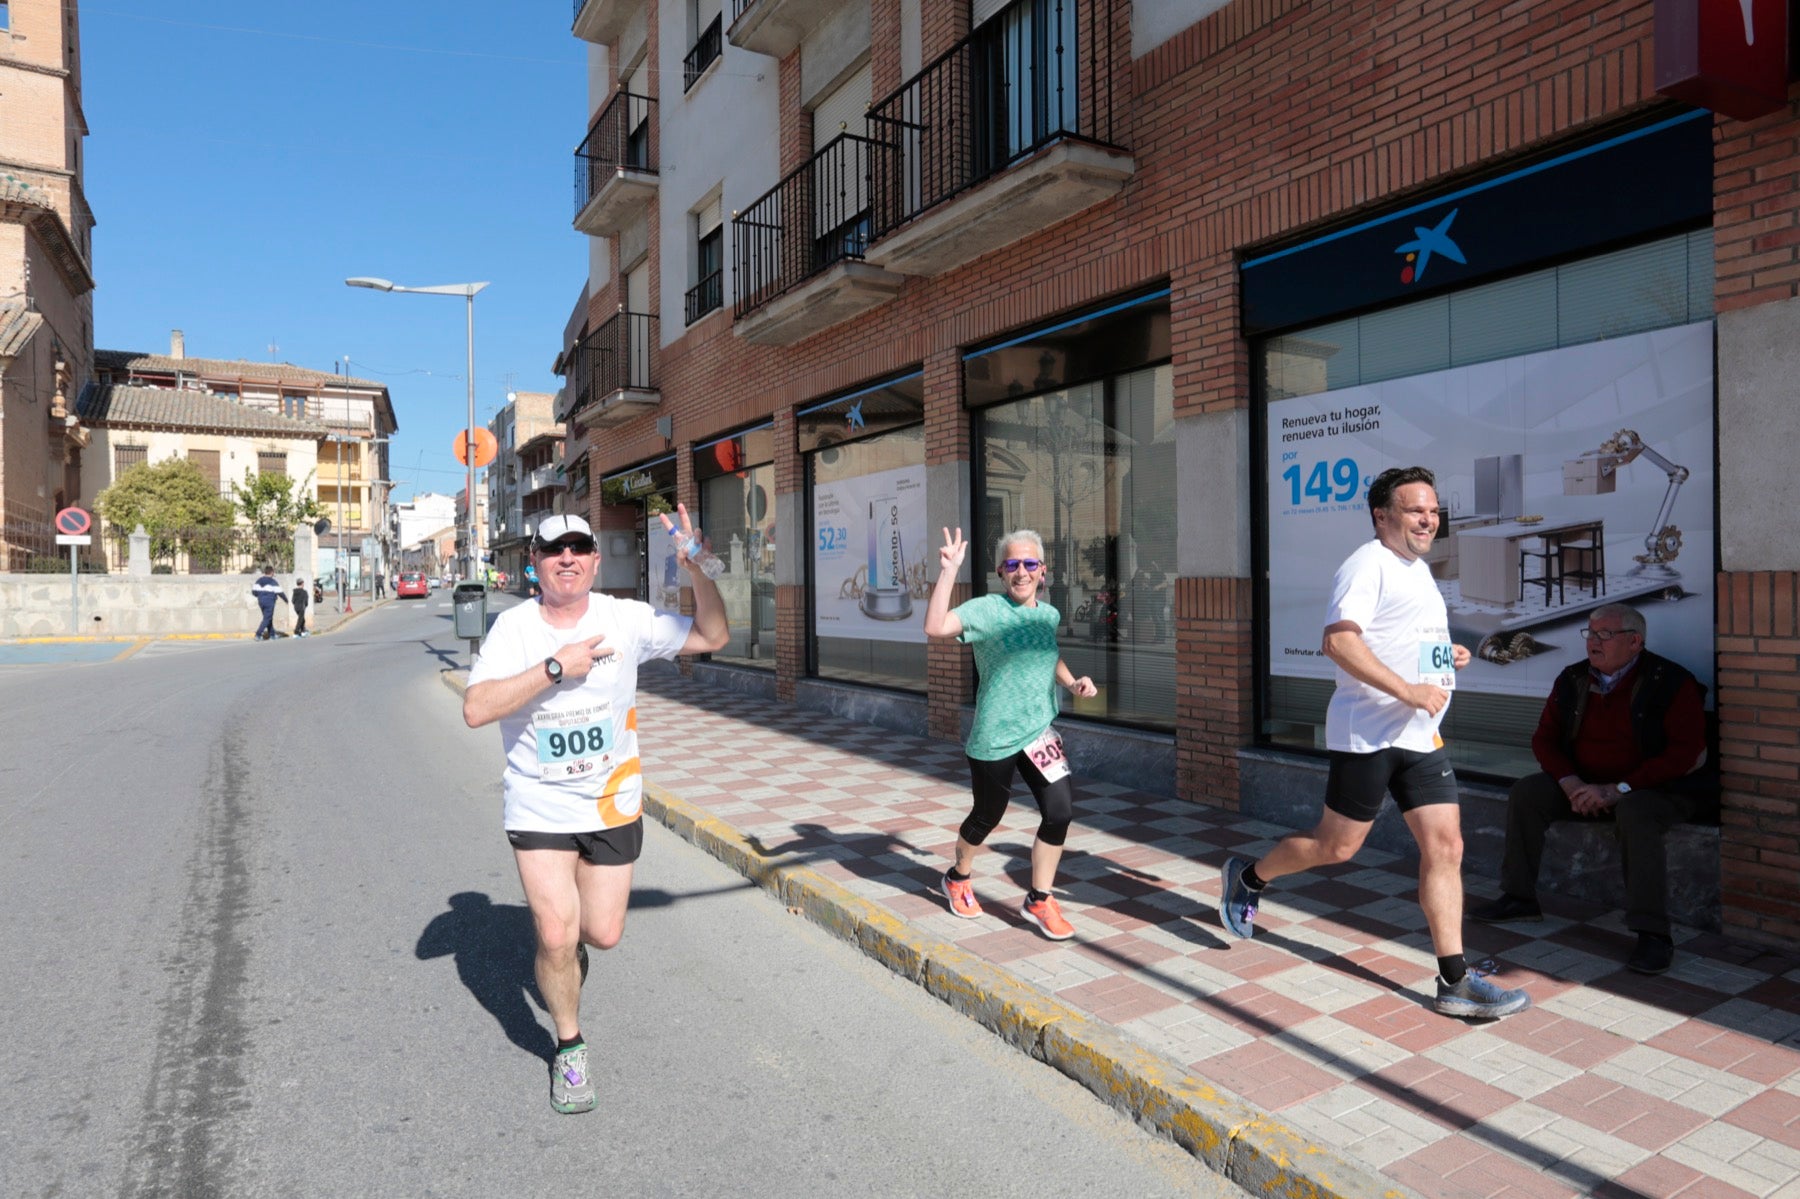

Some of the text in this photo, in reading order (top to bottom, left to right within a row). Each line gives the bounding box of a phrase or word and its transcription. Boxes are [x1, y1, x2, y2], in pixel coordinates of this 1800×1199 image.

[1282, 404, 1381, 429] Renueva tu hogar,
[1282, 419, 1380, 442] renueva tu ilusión
[1282, 451, 1298, 462] por
[1282, 457, 1359, 505] 149
[890, 505, 898, 526] 5G
[1284, 647, 1314, 656] Disfrutar
[549, 726, 604, 758] 908
